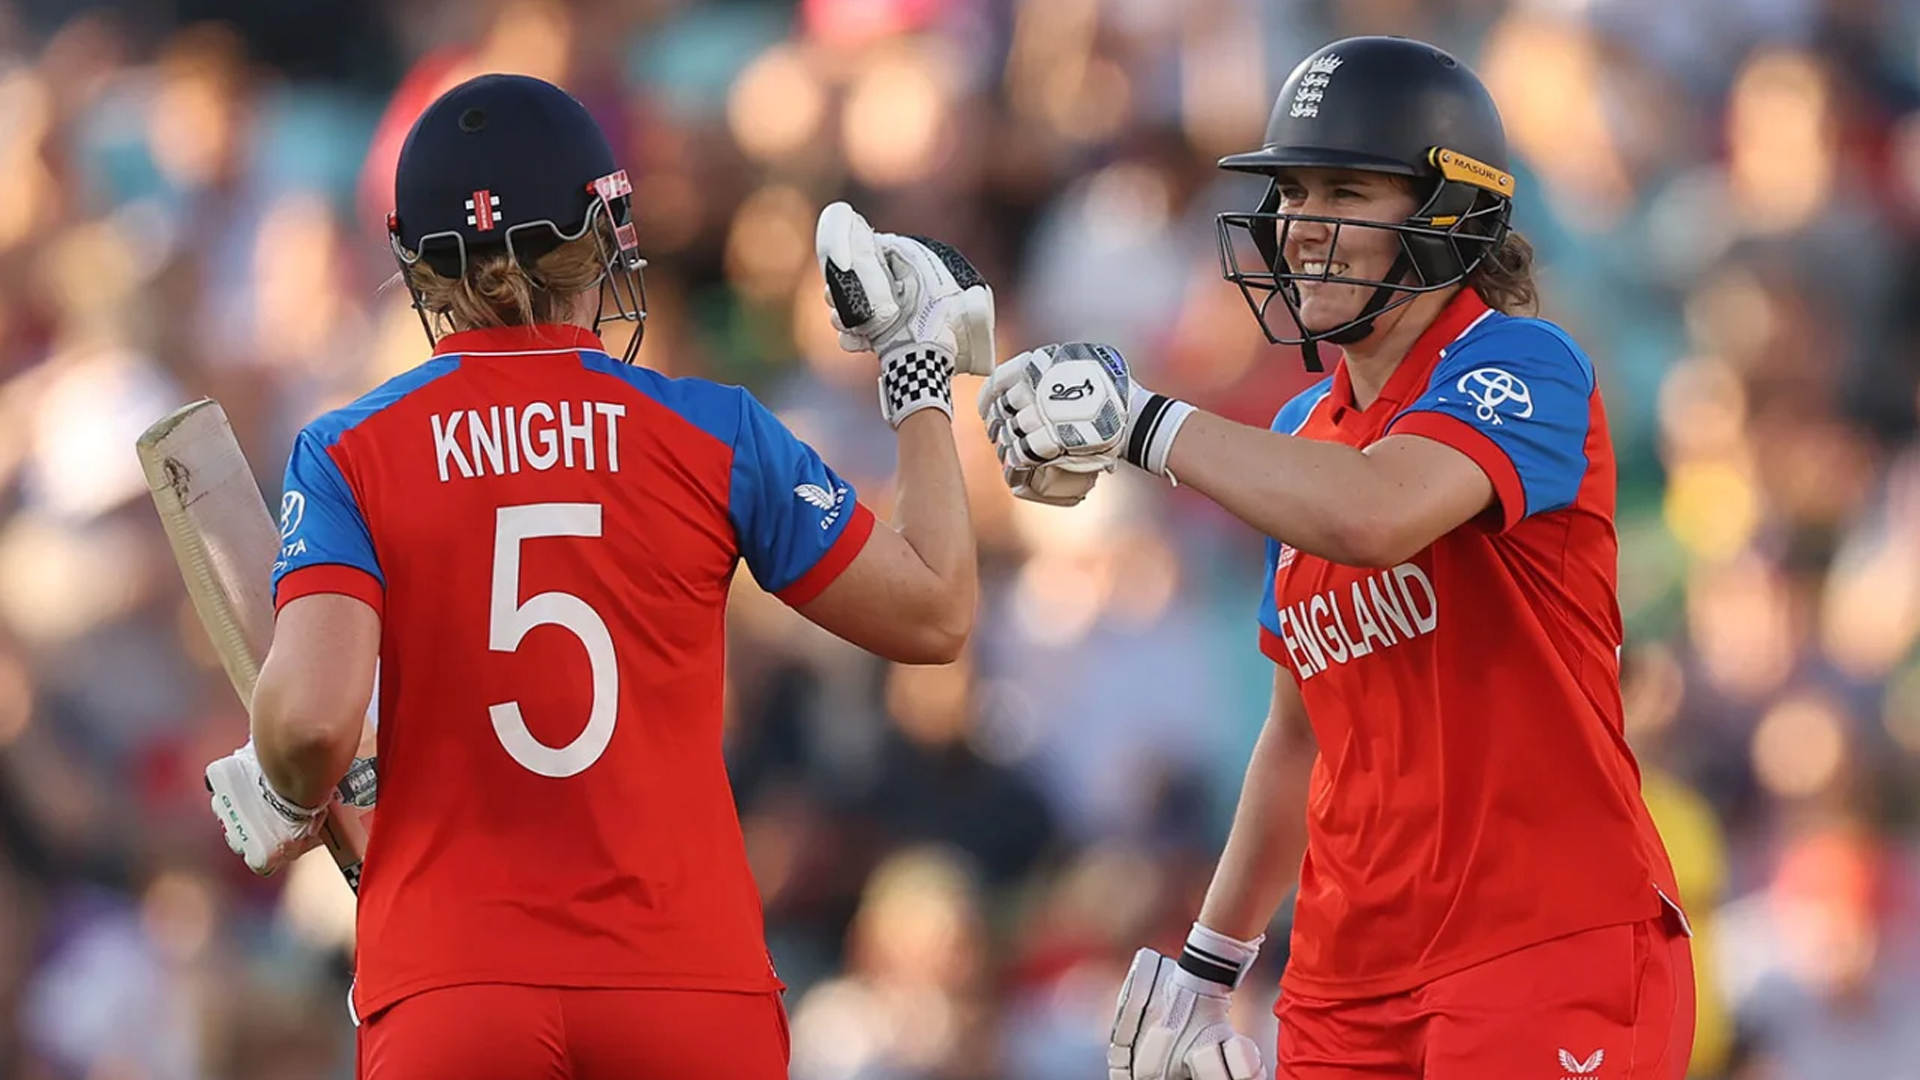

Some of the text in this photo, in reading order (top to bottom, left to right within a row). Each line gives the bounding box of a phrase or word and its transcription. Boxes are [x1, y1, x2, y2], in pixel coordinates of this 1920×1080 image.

[1454, 159, 1497, 180] MASURI
[430, 401, 626, 482] KNIGHT
[488, 502, 619, 778] 5
[1279, 562, 1437, 680] ENGLAND
[221, 794, 250, 843] GEM
